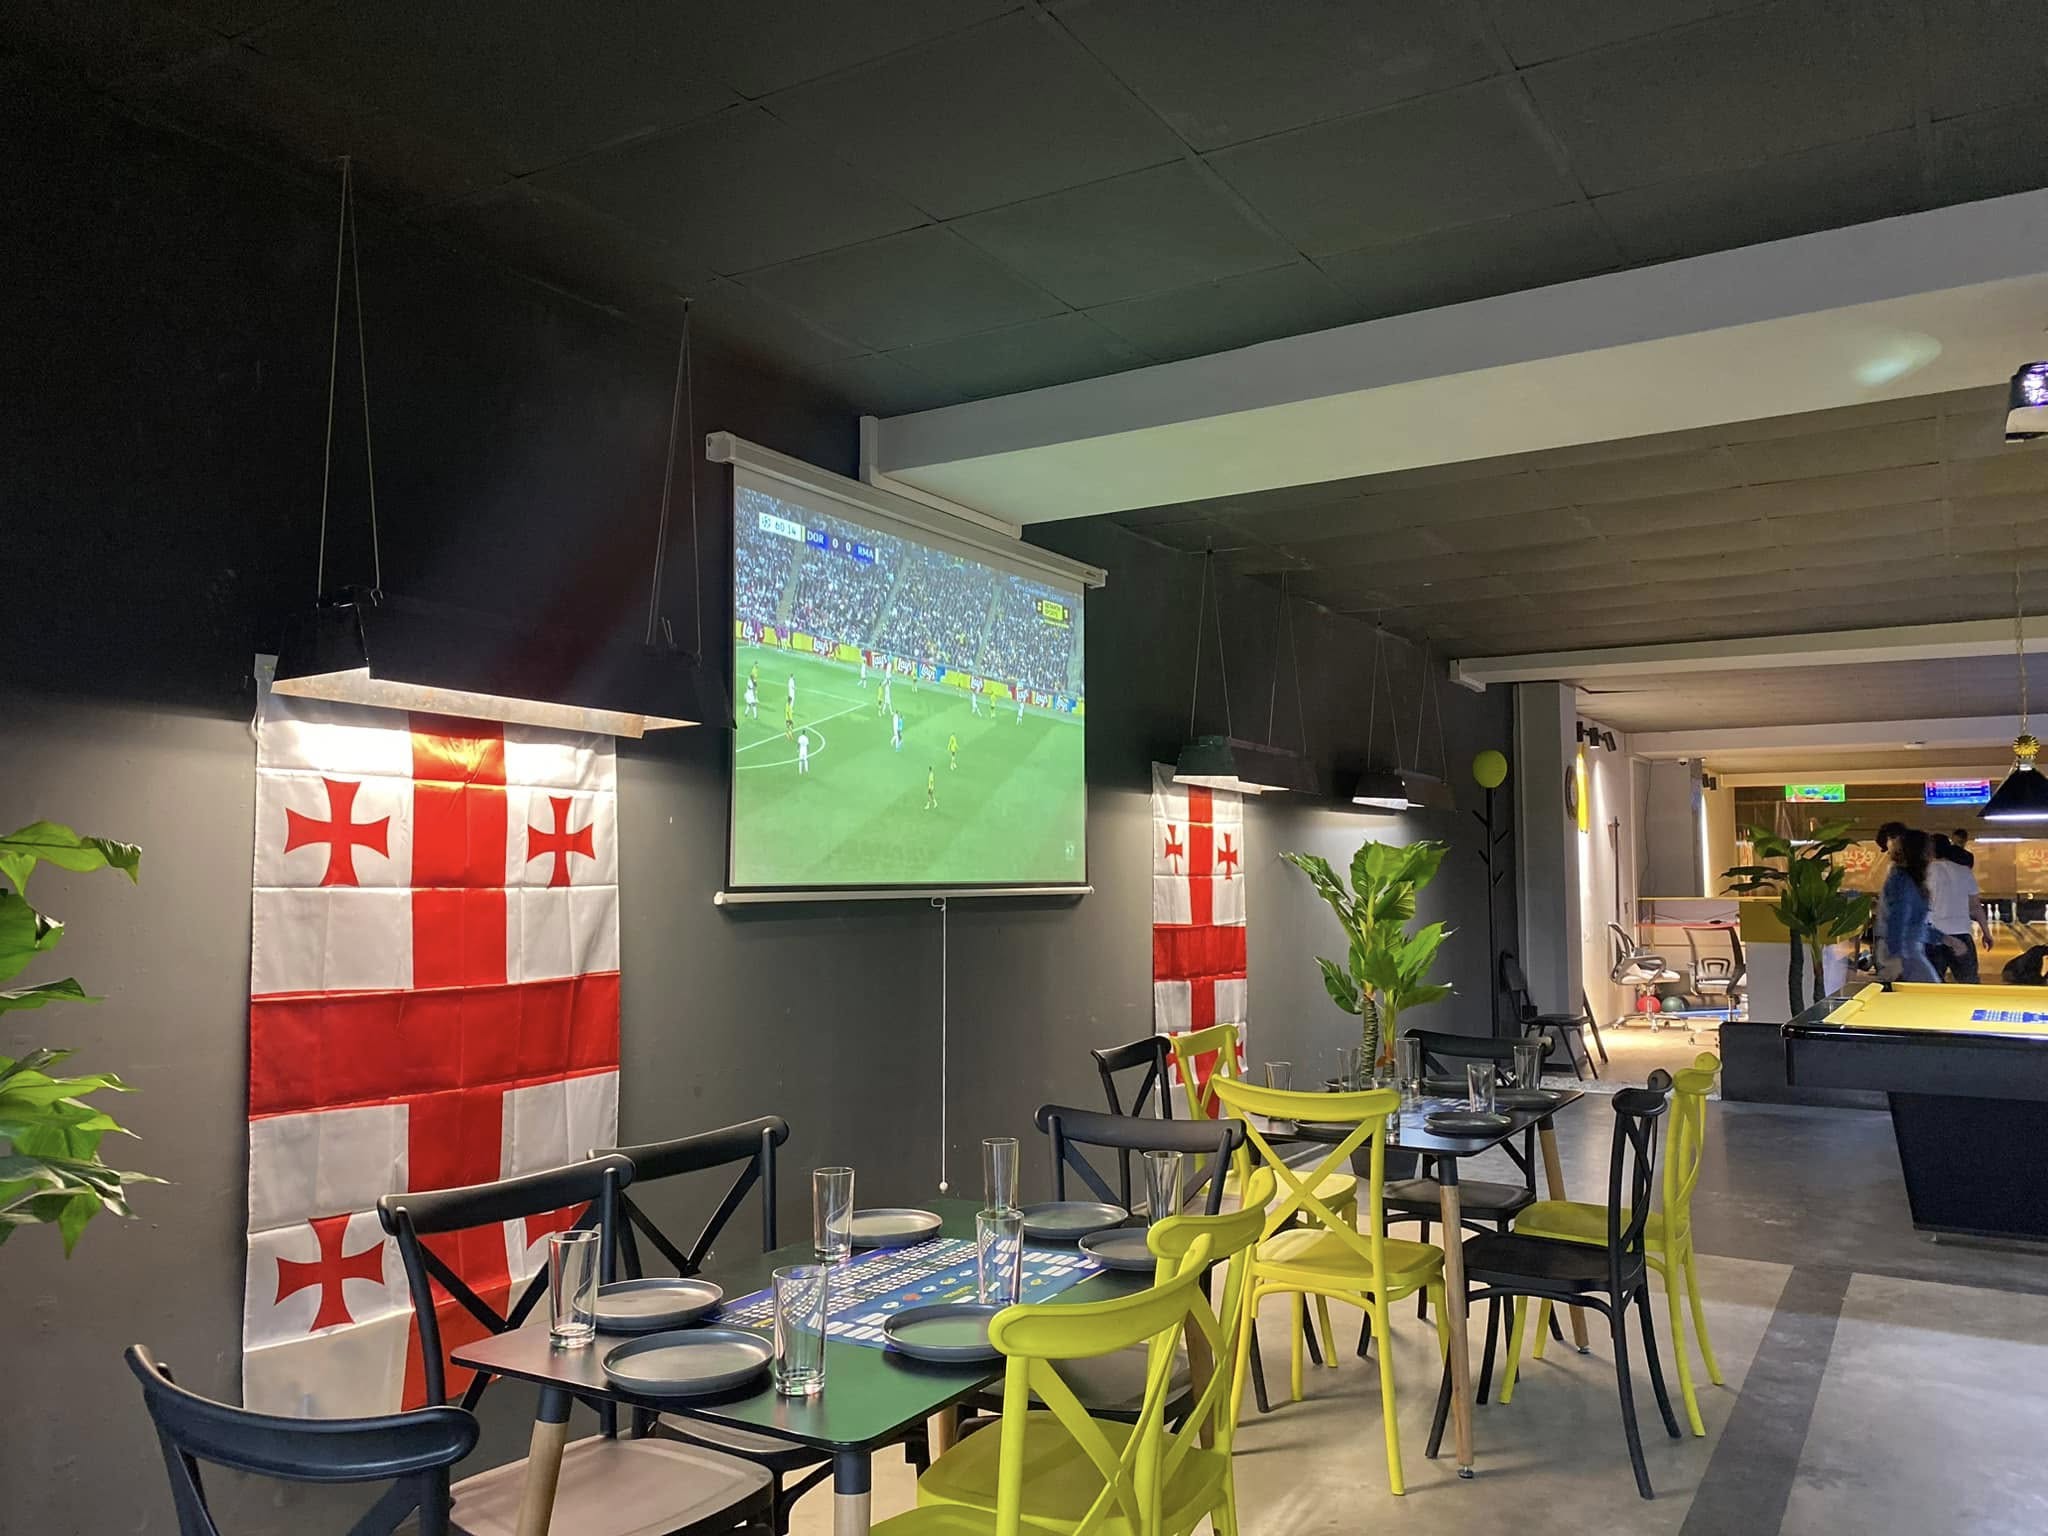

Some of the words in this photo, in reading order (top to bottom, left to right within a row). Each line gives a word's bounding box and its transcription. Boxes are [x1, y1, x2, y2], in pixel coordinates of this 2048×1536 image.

[808, 531, 824, 544] DOR
[833, 538, 839, 548] 0
[845, 542, 851, 552] 0
[858, 546, 874, 559] RMA
